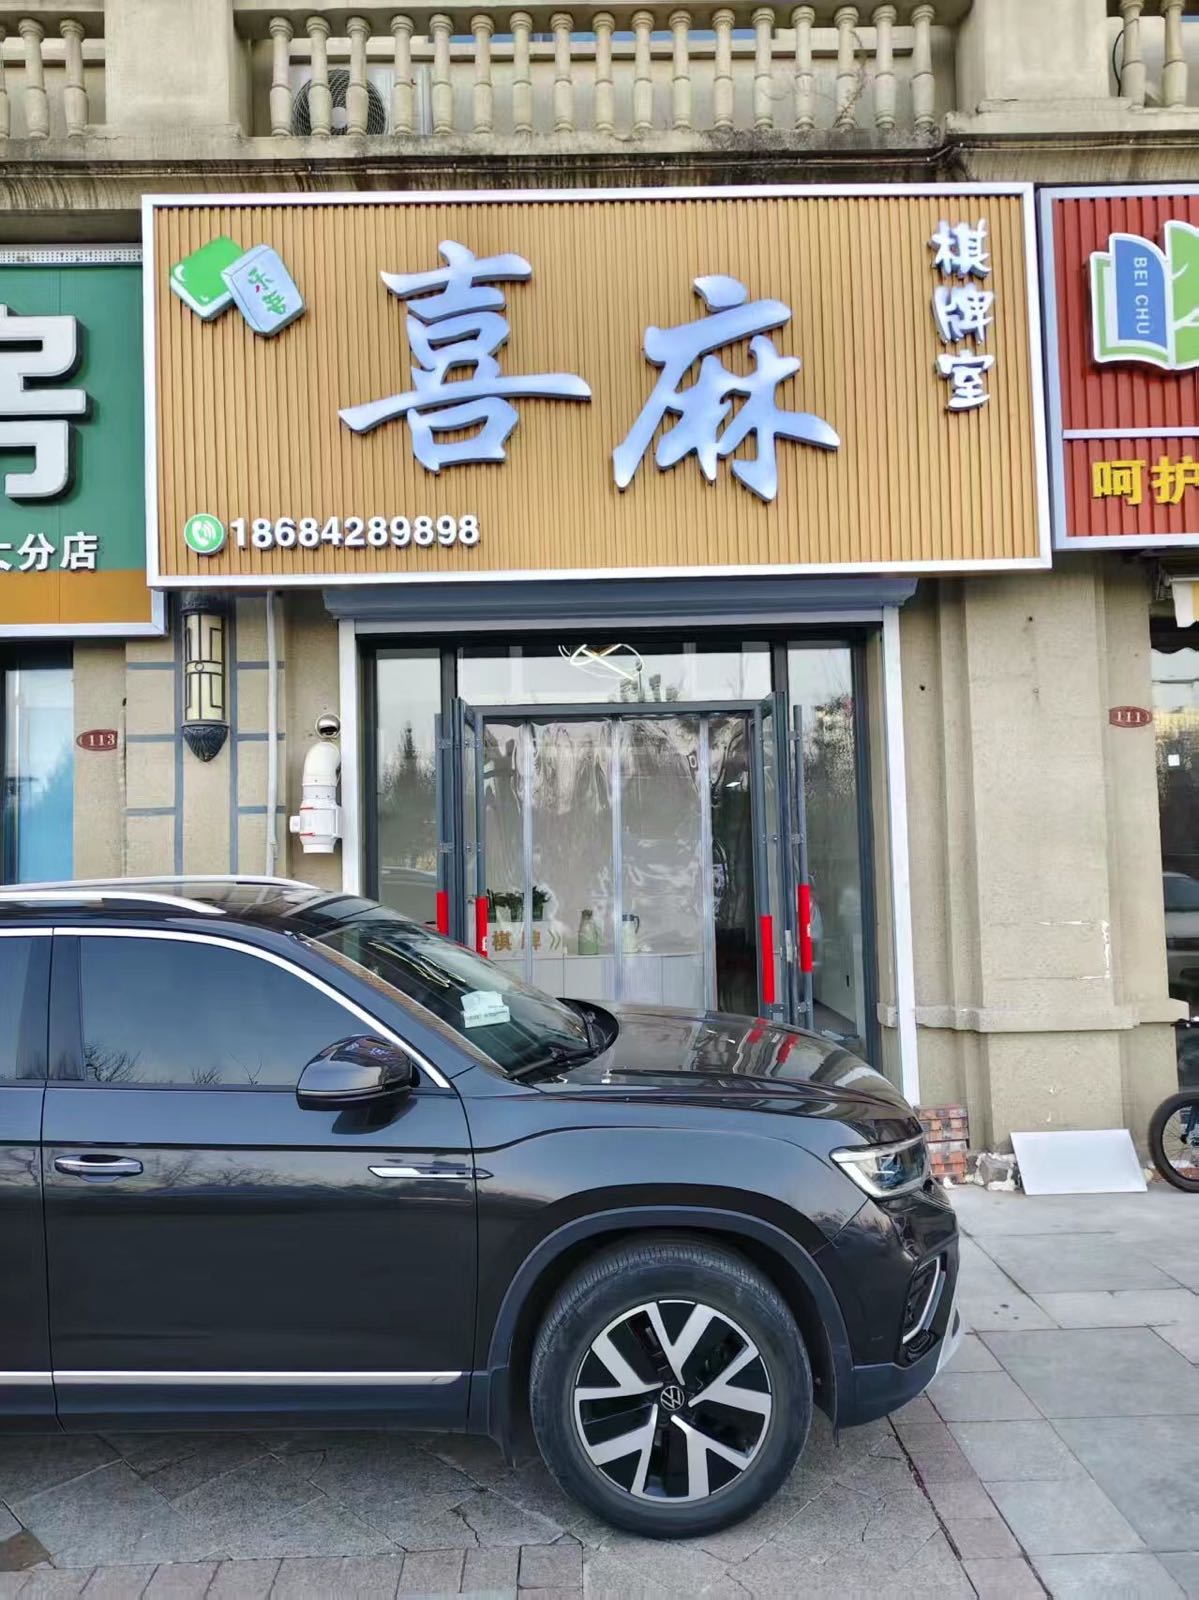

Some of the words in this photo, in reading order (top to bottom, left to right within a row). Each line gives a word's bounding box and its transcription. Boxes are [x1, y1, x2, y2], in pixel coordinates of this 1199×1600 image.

[1133, 257, 1148, 287] BEI
[931, 217, 995, 413] 棋牌室
[1135, 294, 1150, 335] CHU
[338, 239, 841, 502] 喜麻
[1092, 455, 1199, 505] 呵护
[230, 514, 480, 548] 18684289898
[1117, 711, 1141, 723] 111
[89, 733, 116, 746] 113
